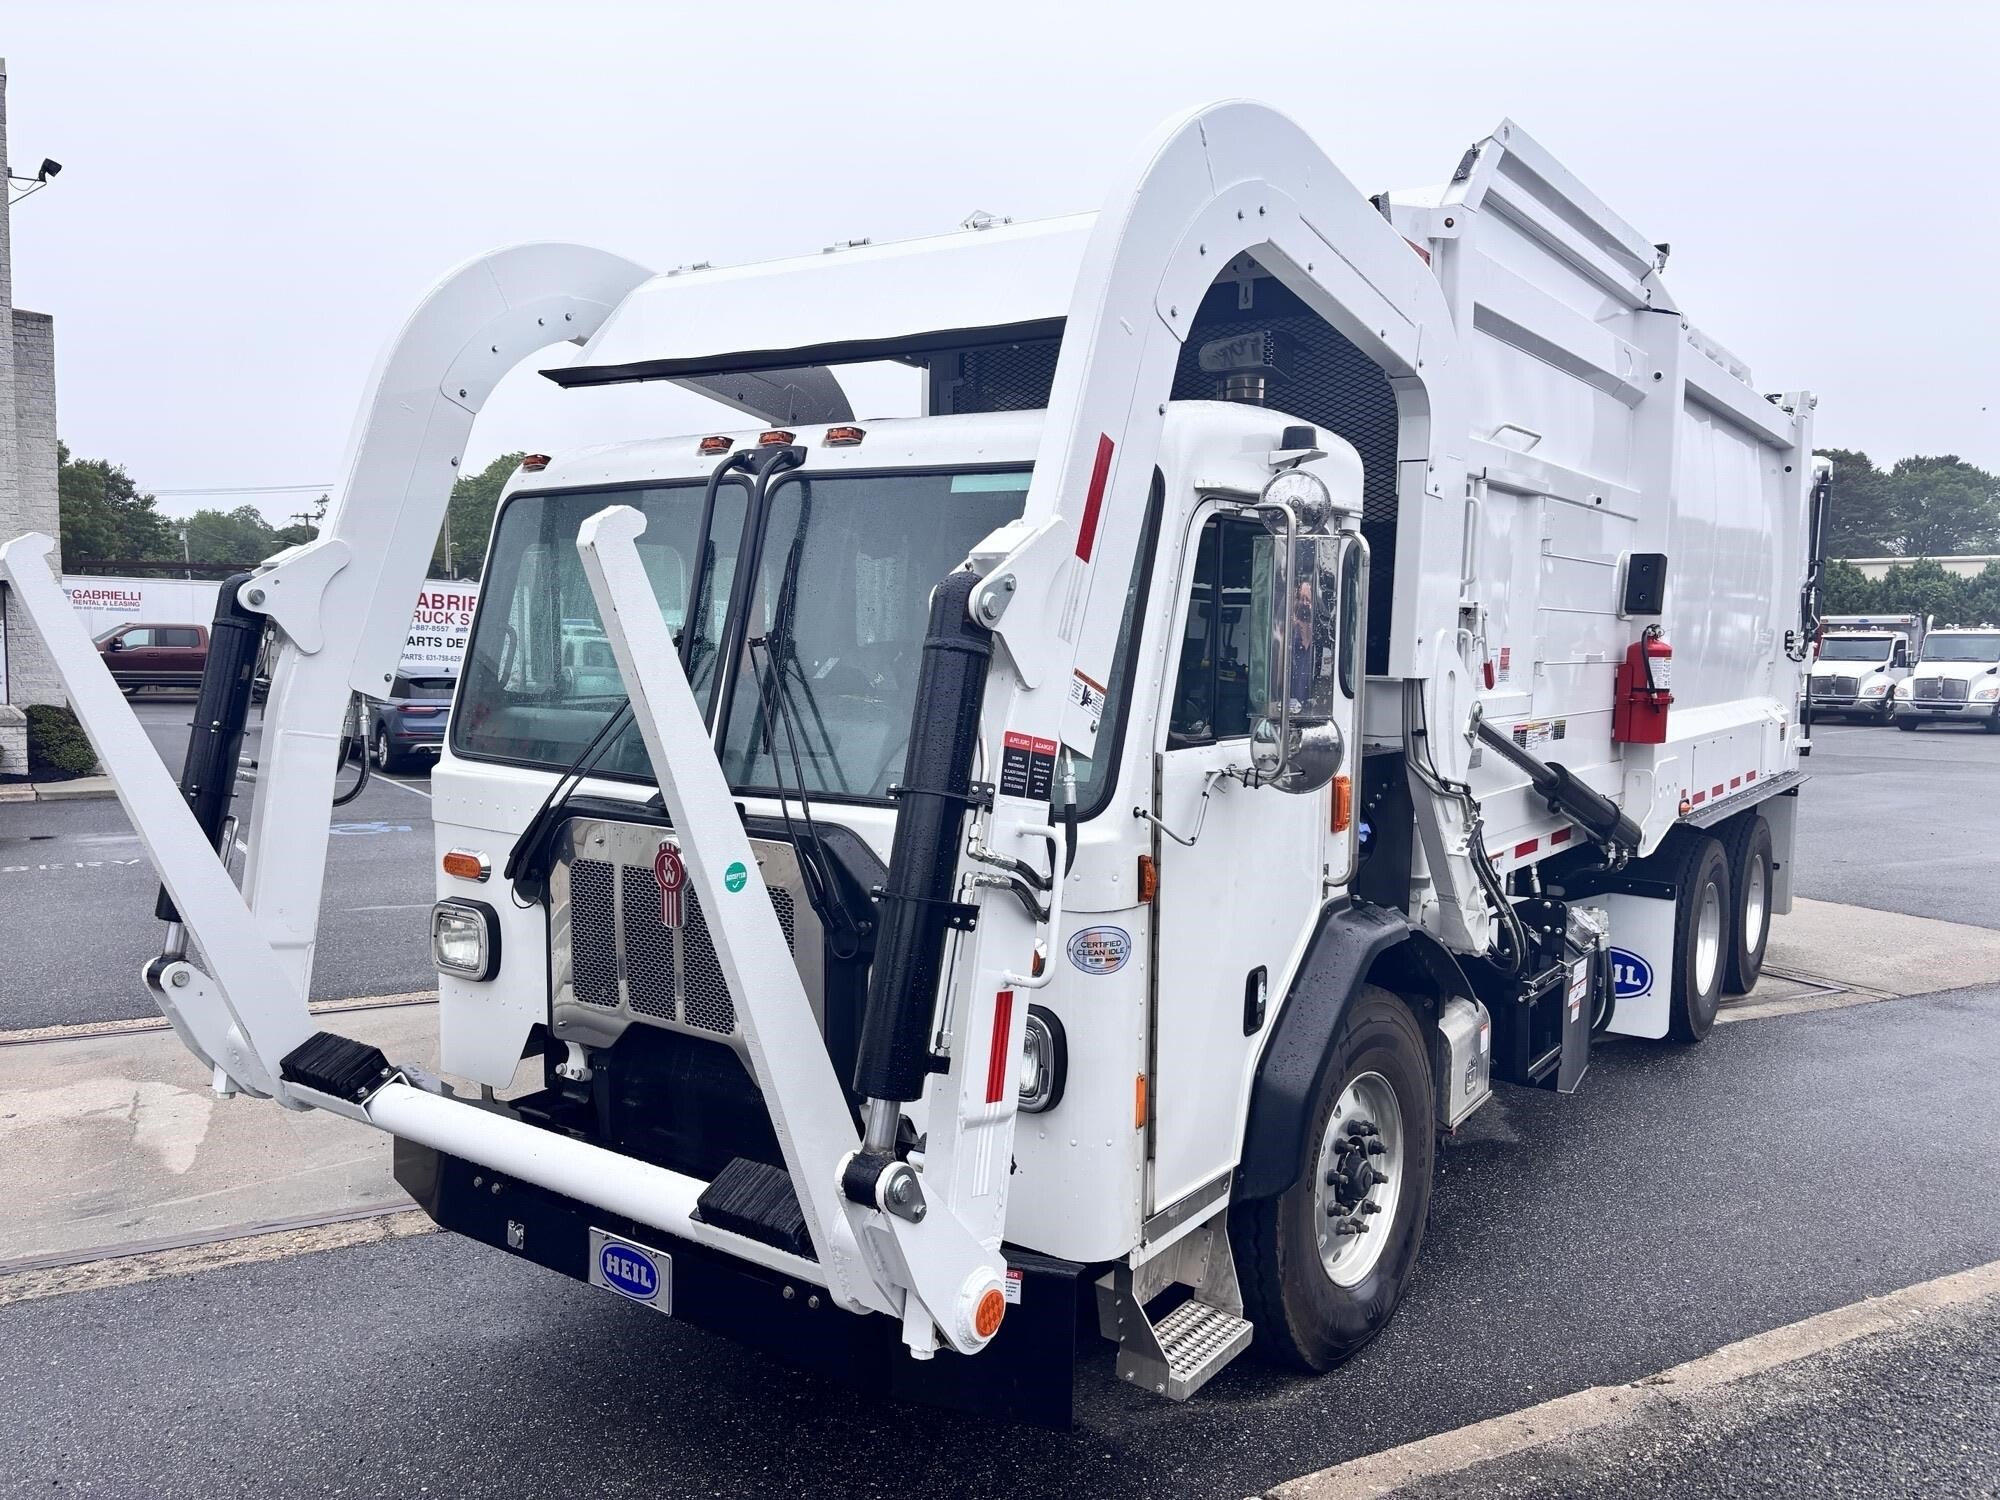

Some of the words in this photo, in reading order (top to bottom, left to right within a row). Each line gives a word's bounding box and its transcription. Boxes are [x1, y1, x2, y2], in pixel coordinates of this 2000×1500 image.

[72, 589, 141, 601] GABRIELLI
[417, 592, 477, 611] ABRIE
[413, 610, 455, 625] RUCK
[407, 636, 442, 648] ARTS
[1081, 940, 1122, 949] CERTIFIED
[1109, 947, 1124, 955] IDLE
[1613, 963, 1642, 986] IL
[605, 1252, 652, 1289] HEIL
